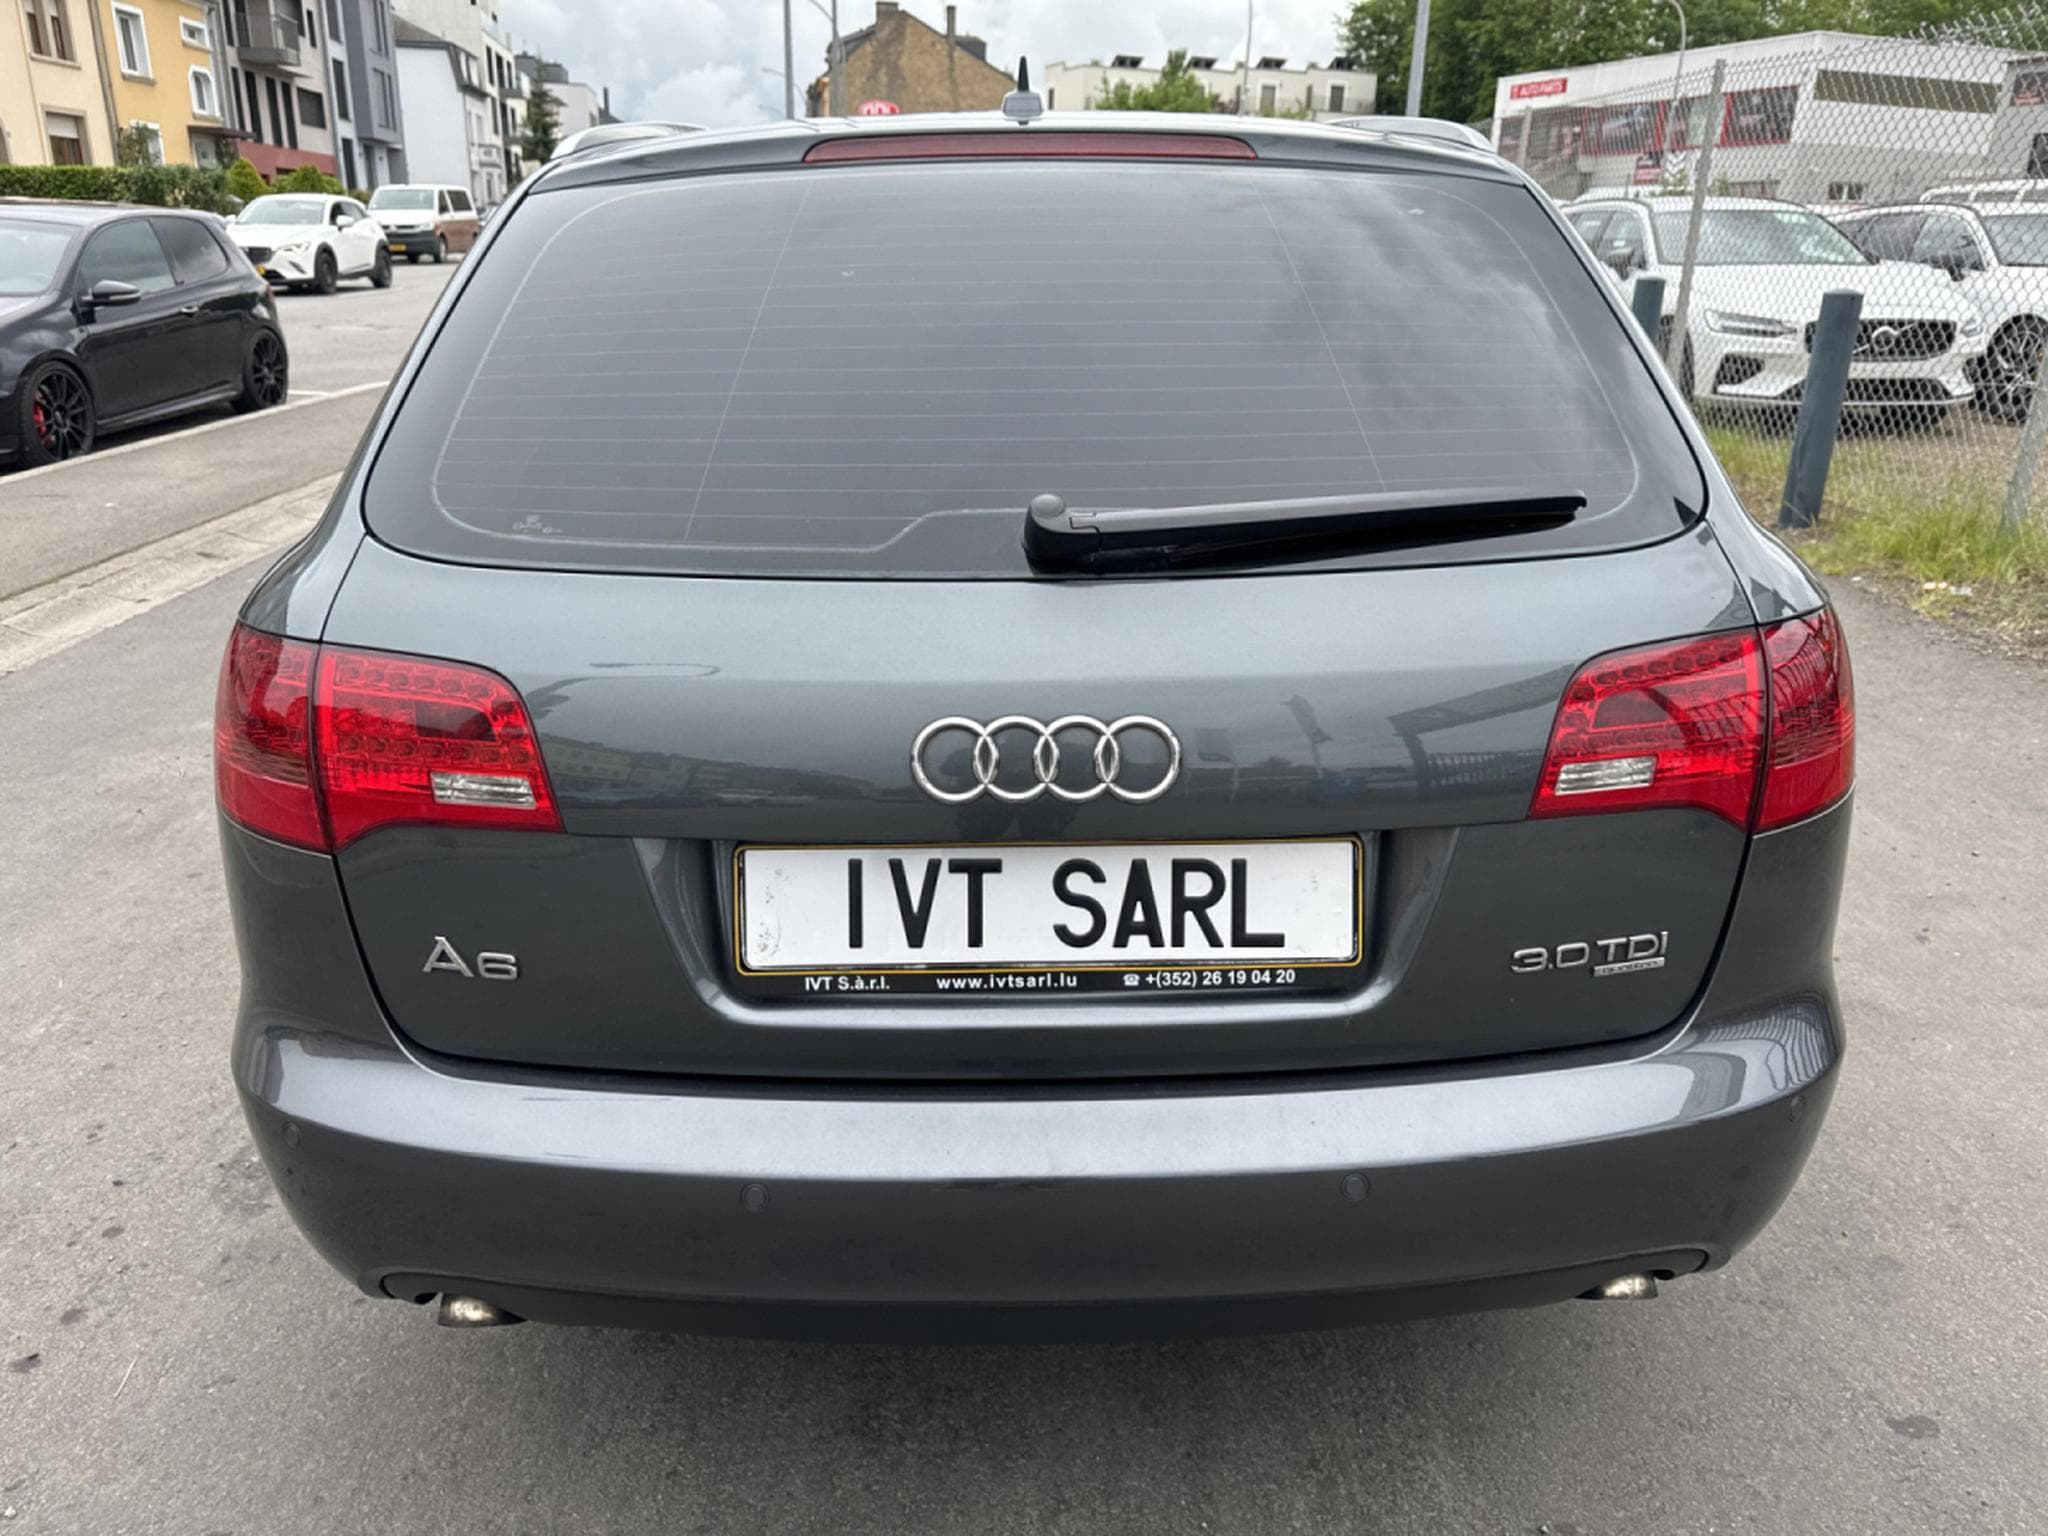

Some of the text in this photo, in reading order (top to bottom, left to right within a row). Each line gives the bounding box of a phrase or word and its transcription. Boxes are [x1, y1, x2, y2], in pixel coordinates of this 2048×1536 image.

[848, 858, 1285, 949] IVT SARL
[422, 935, 518, 980] A6
[1511, 941, 1590, 974] 3.0
[1596, 930, 1669, 961] TDI
[804, 975, 890, 991] IVT S.à.r.l.
[936, 972, 1078, 990] www.ivtsarl.lu
[1145, 968, 1296, 988] +(352) 26 19 04 20
